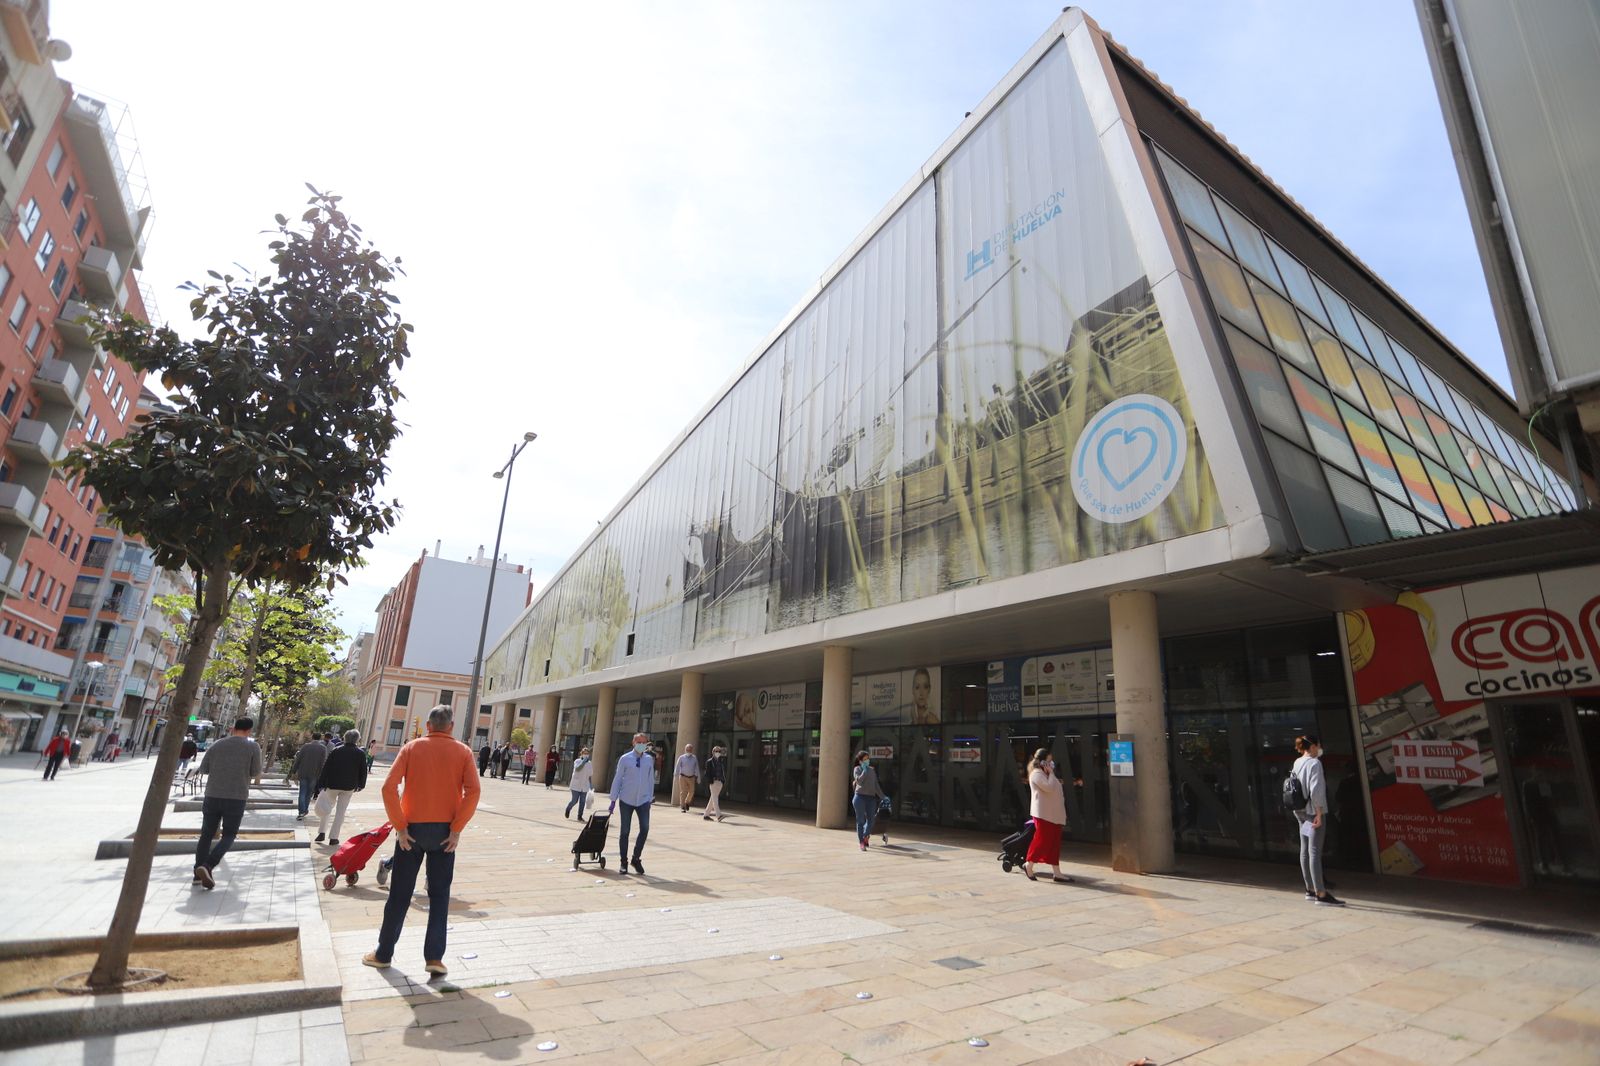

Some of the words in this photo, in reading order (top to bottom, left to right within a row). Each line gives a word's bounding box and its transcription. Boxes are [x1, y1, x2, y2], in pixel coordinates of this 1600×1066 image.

[1012, 204, 1062, 244] HUELVA
[1090, 498, 1107, 513] sea
[1110, 503, 1122, 515] de
[1125, 482, 1162, 513] Huelva
[1451, 595, 1600, 677] ca
[1465, 666, 1592, 696] cocinas
[988, 700, 1020, 713] Huelva
